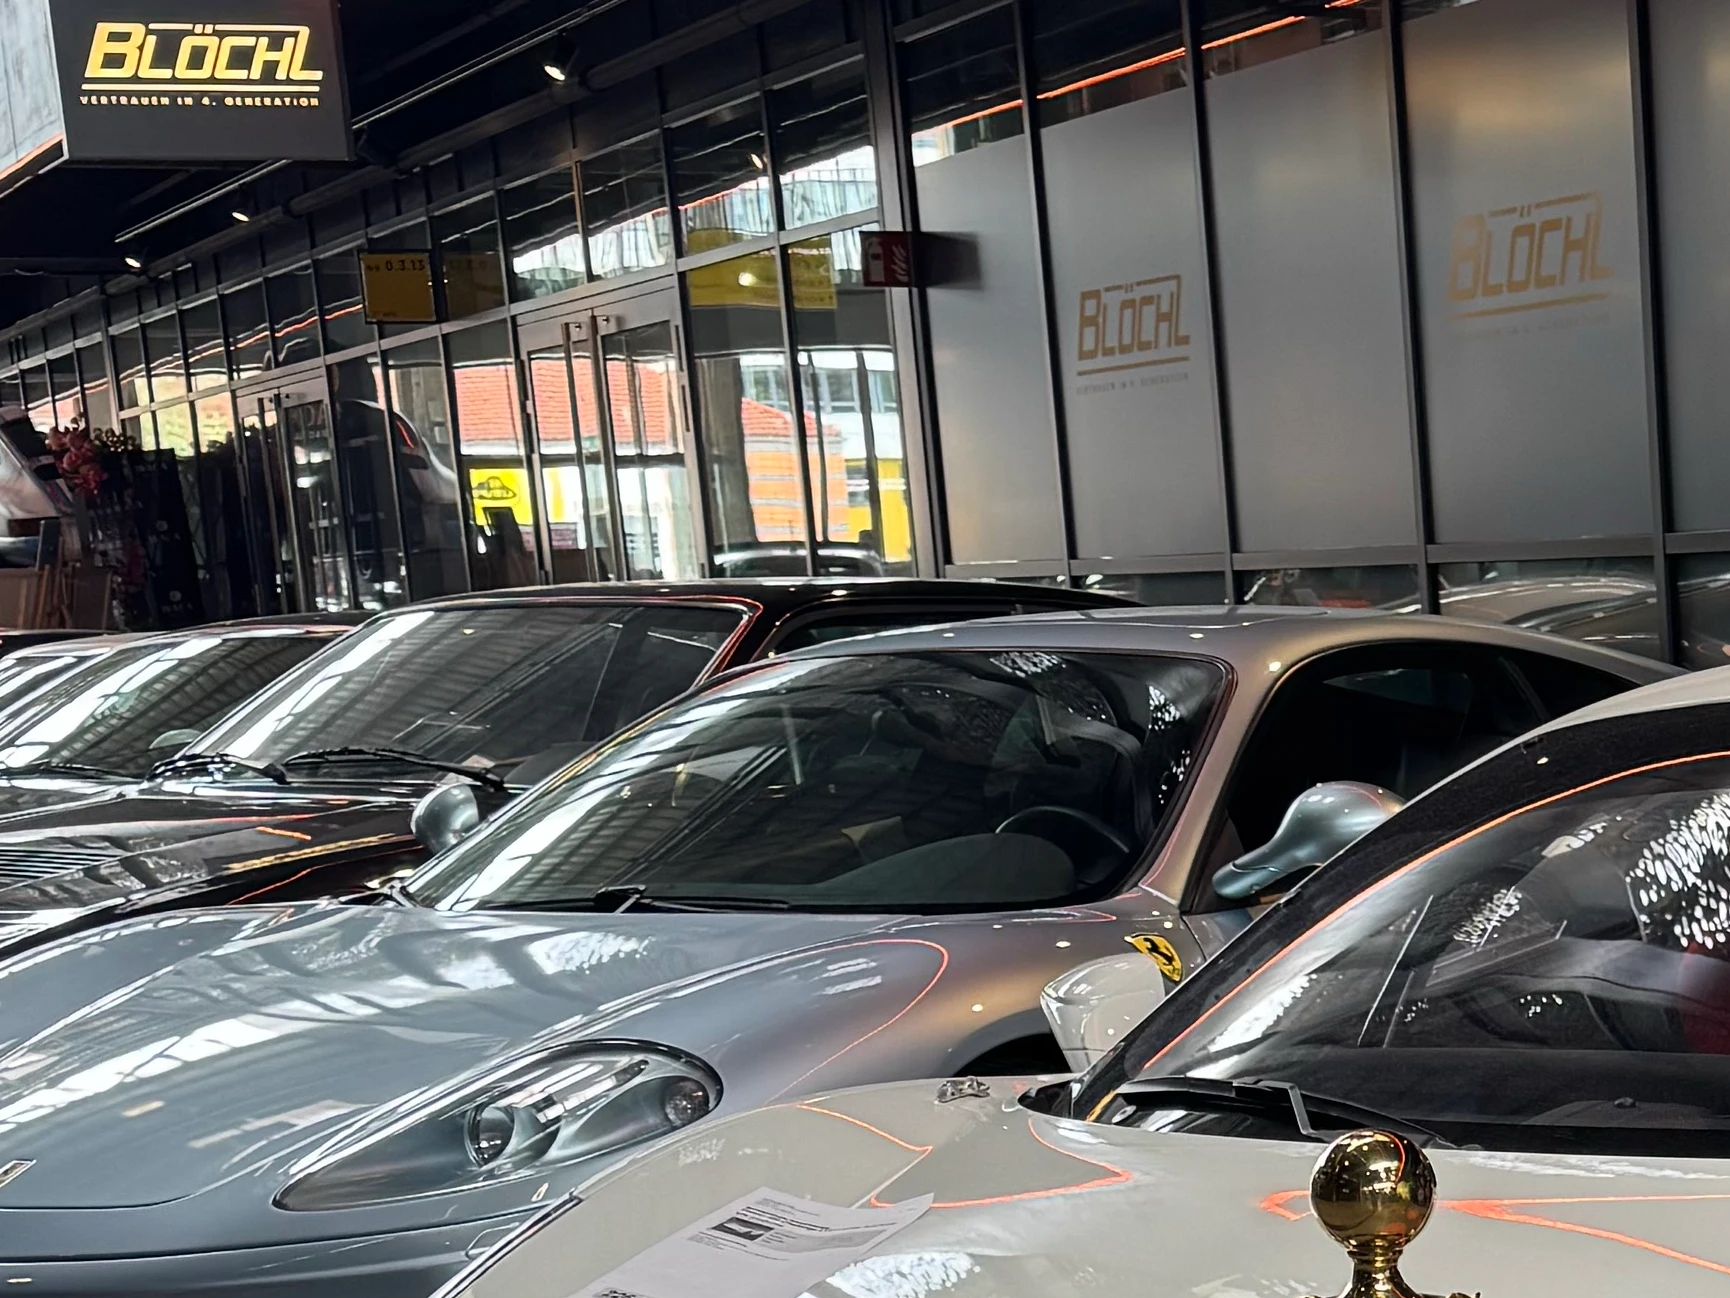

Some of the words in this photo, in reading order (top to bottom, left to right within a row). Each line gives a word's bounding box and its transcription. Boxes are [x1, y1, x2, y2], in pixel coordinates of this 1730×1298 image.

[84, 22, 323, 81] BLÖCHL
[79, 95, 170, 106] VERTRAUEN
[176, 96, 194, 106] IN
[224, 96, 319, 107] GENERATION
[1447, 189, 1614, 302] BLÖCHL
[1077, 274, 1191, 361] BLÖCHL
